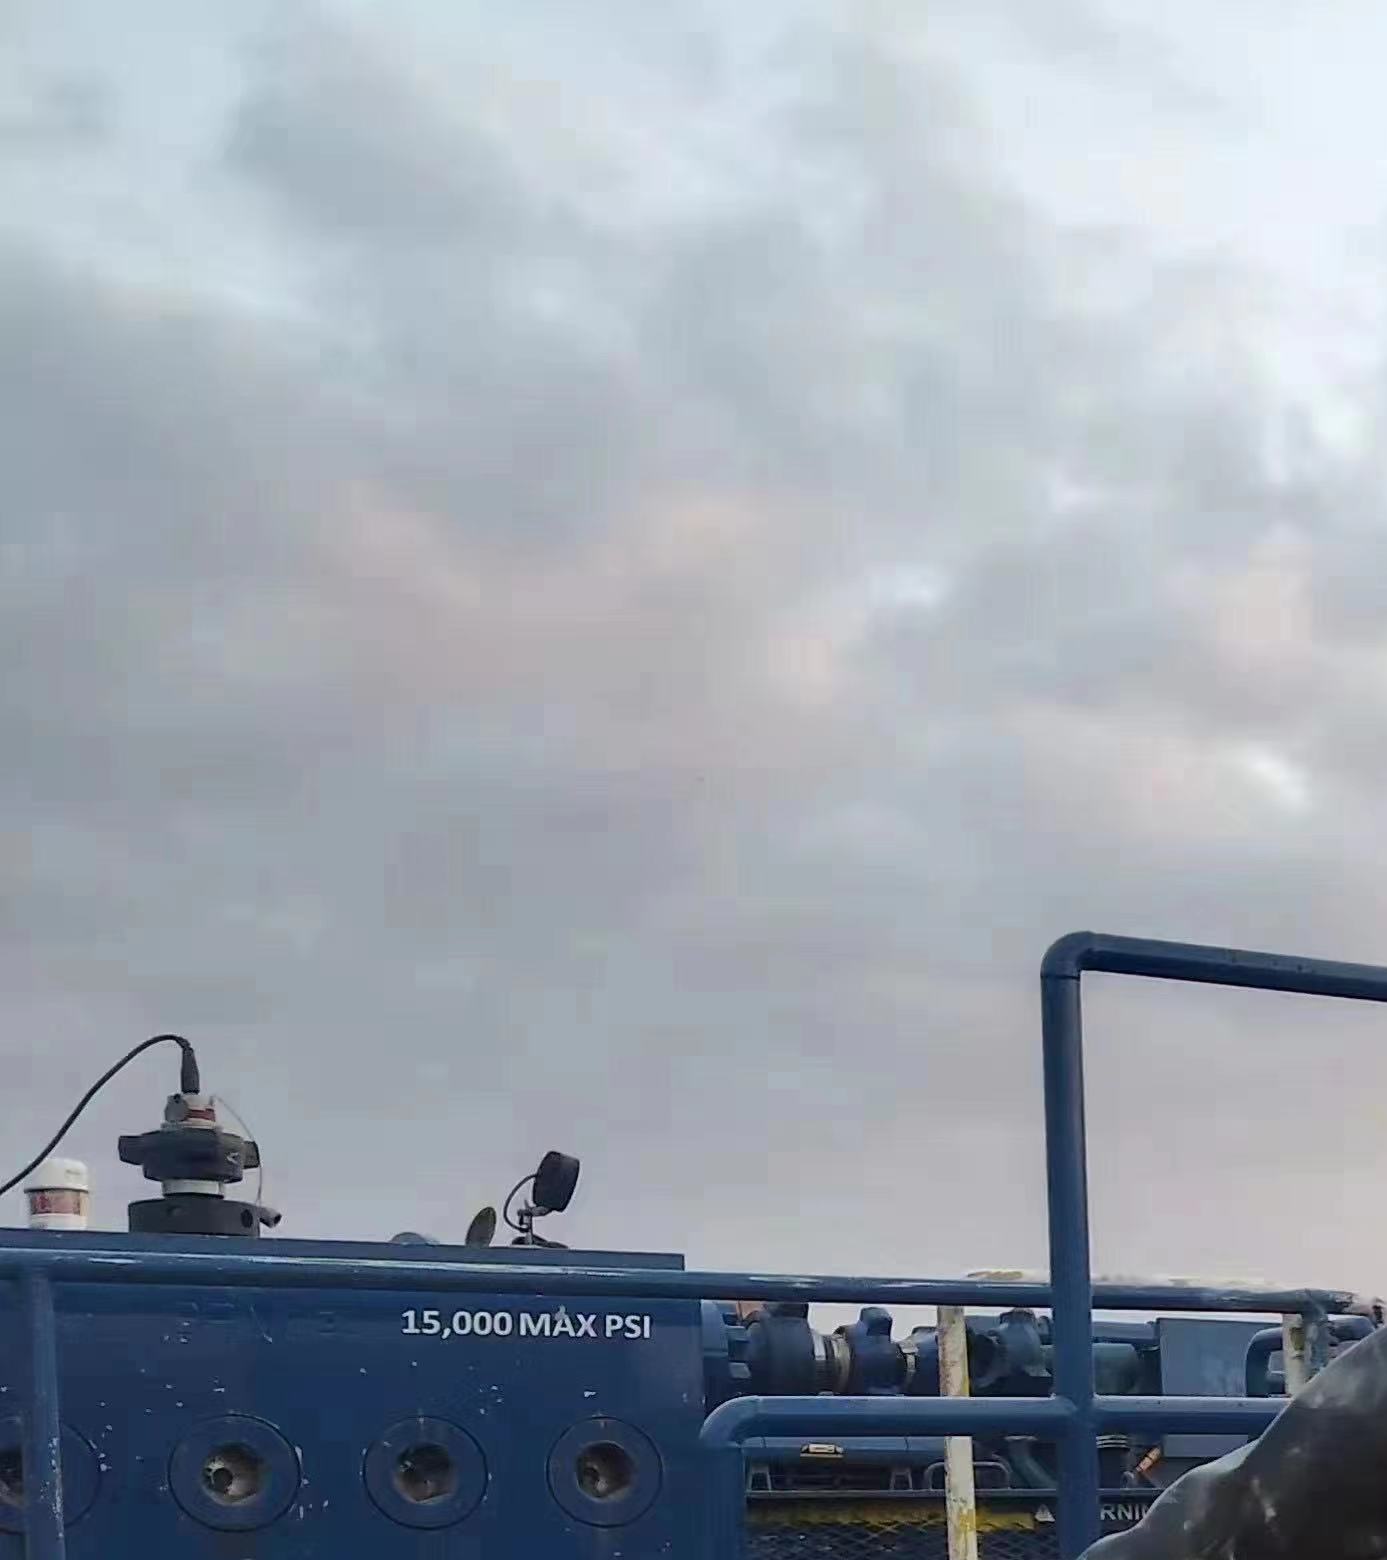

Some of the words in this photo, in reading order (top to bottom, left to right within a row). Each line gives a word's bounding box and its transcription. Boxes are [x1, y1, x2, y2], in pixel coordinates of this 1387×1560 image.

[401, 1310, 512, 1339] 15,000
[519, 1313, 597, 1337] MAX
[605, 1315, 650, 1338] PSI
